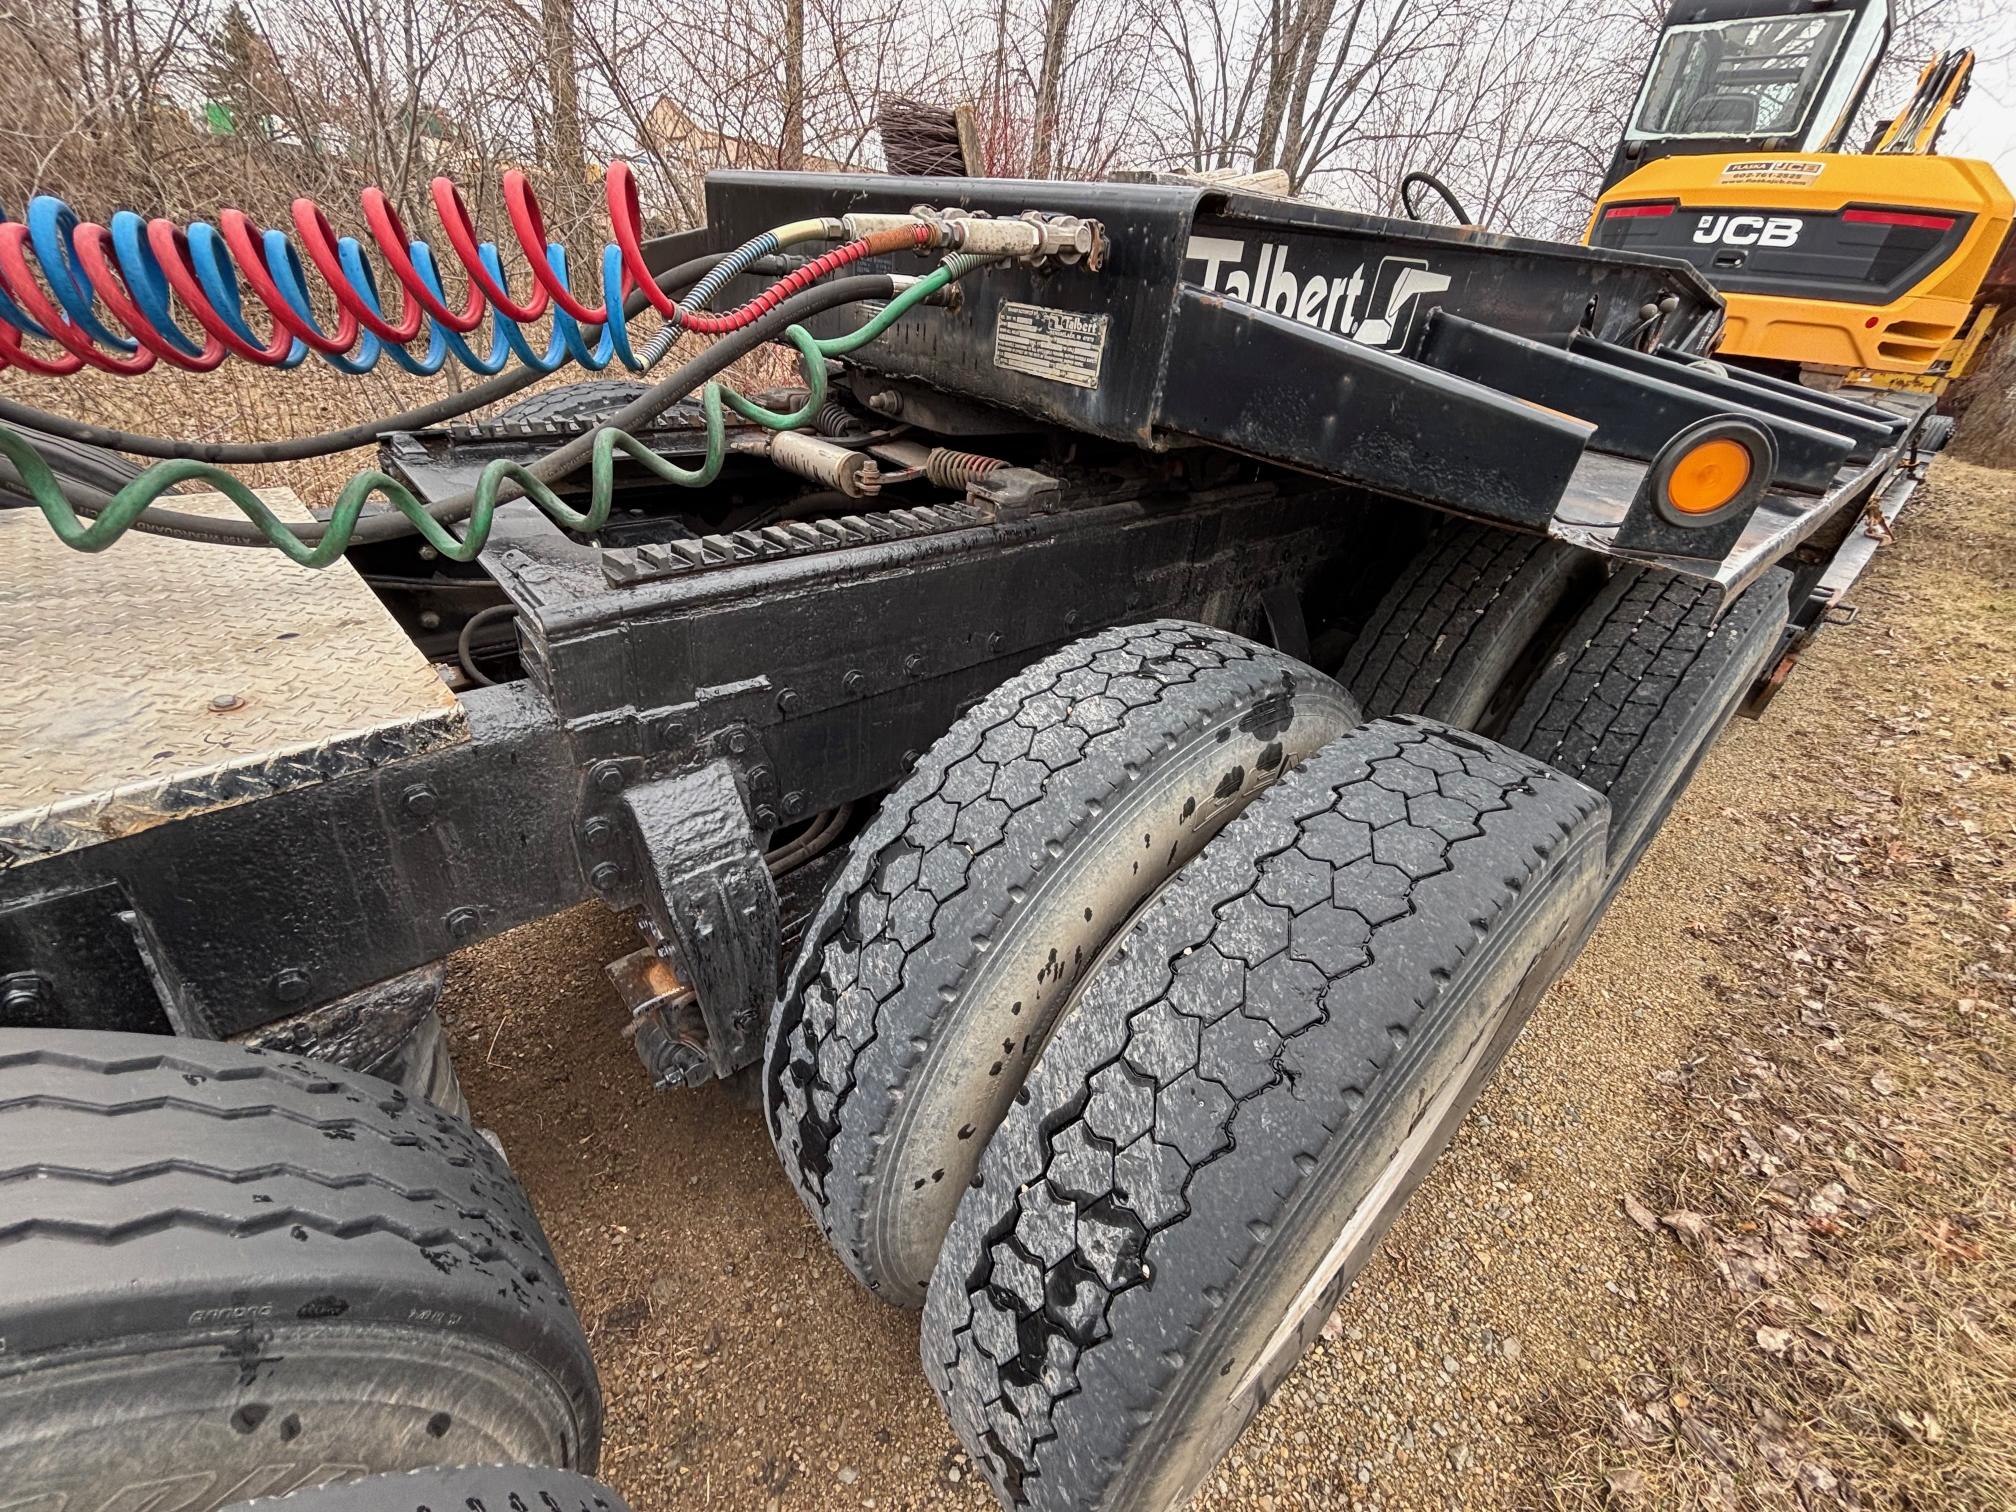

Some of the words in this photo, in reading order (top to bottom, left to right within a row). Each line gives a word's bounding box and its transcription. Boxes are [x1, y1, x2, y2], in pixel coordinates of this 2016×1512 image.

[1692, 215, 1804, 248] JCB
[1186, 235, 1365, 333] Talbert
[1063, 314, 1098, 333] Talbert
